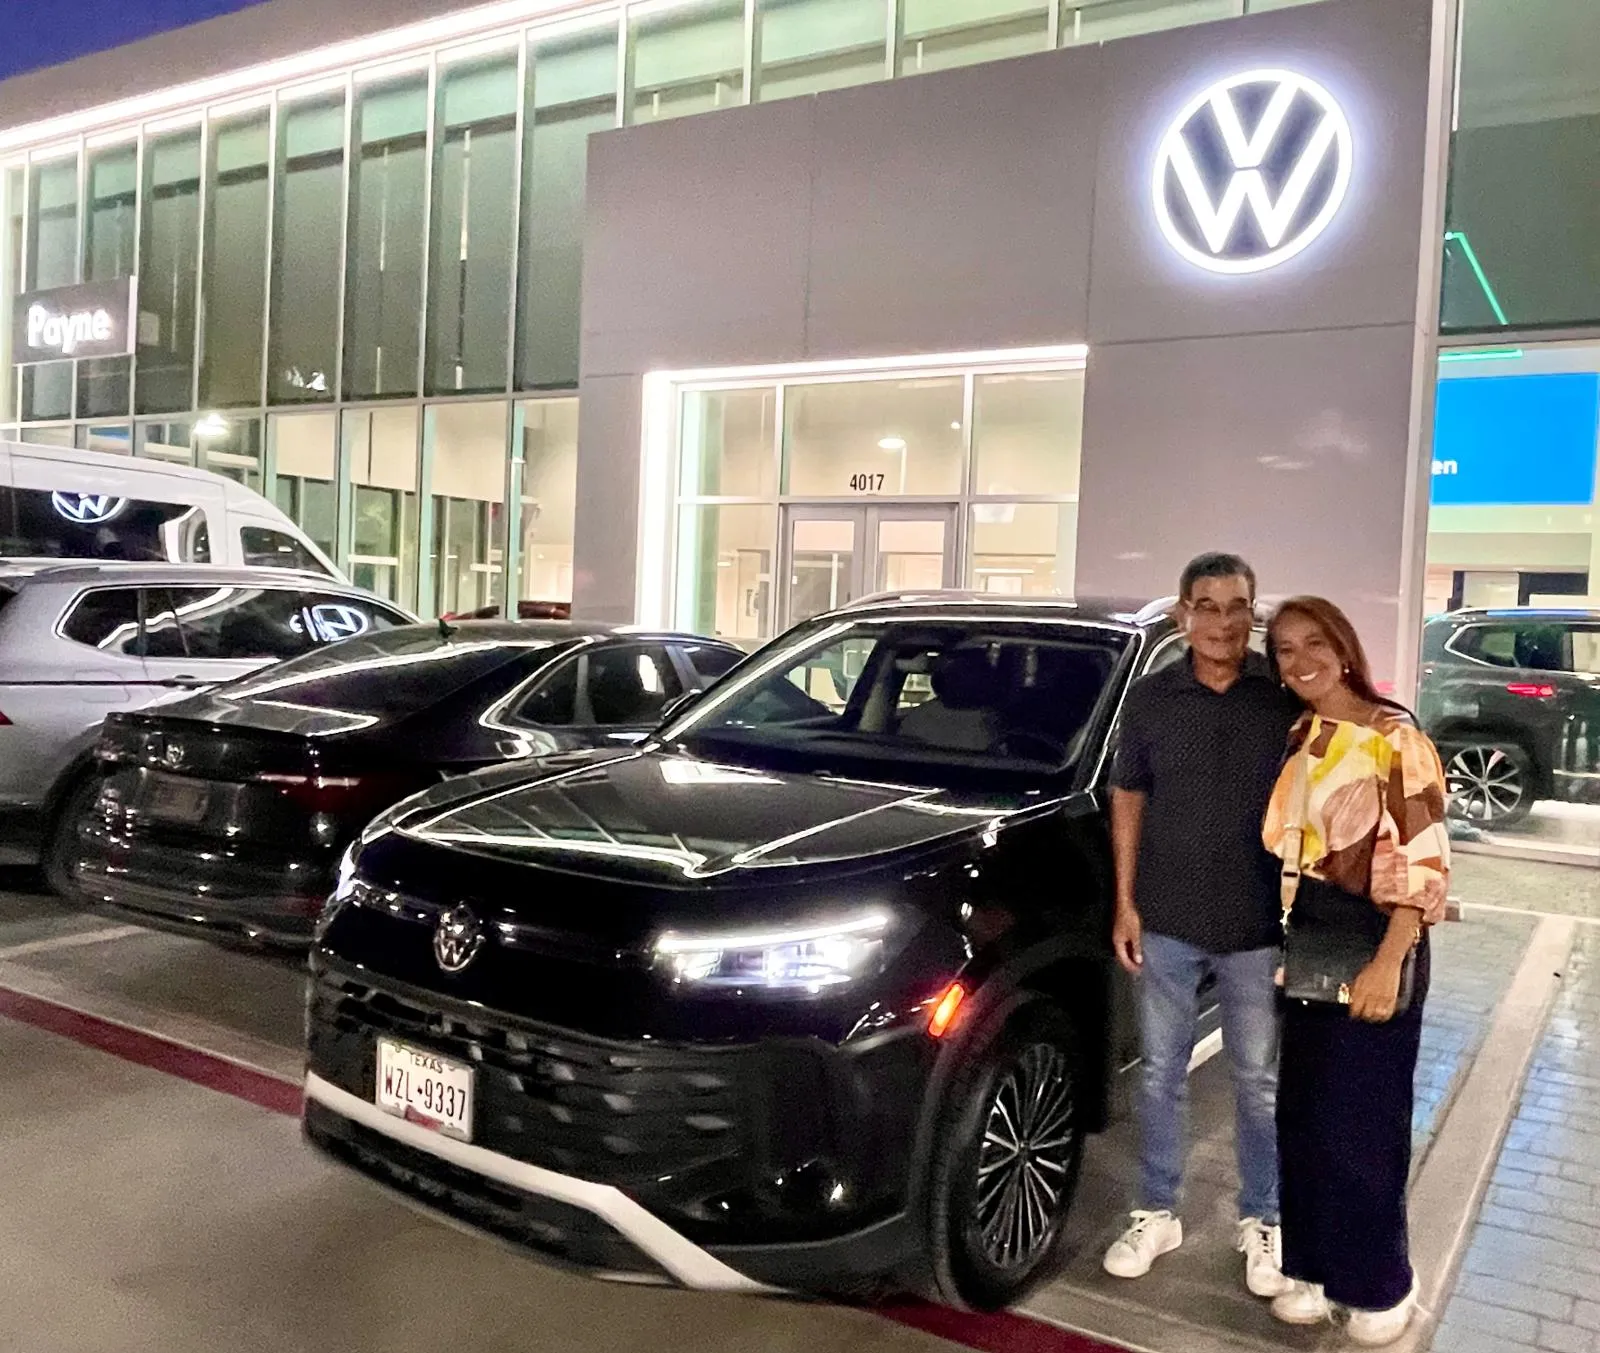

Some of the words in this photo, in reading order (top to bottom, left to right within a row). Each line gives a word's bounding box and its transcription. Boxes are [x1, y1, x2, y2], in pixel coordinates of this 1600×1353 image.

[27, 301, 112, 353] Payne
[849, 473, 885, 491] 4017
[410, 1053, 443, 1074] TEXAS
